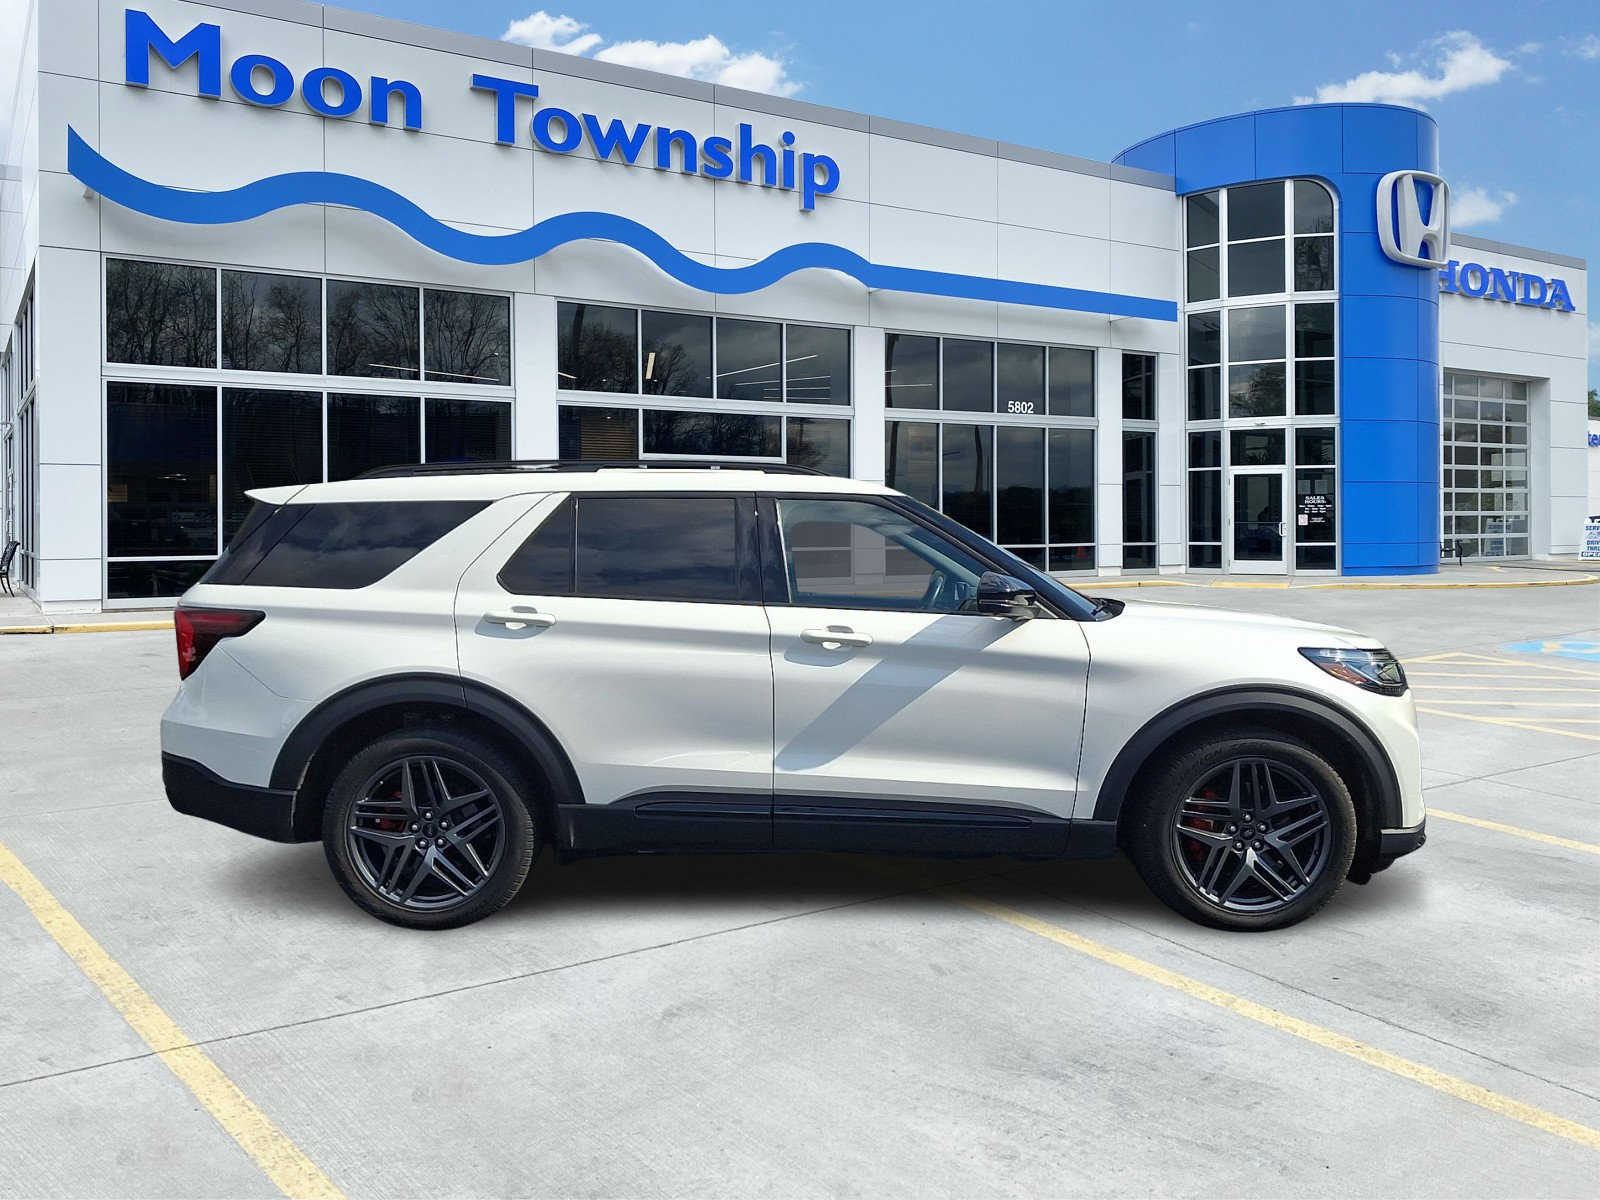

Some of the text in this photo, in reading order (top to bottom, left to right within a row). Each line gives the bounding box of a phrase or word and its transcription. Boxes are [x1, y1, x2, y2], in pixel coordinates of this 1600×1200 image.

[125, 9, 840, 212] Moon Township
[1007, 400, 1034, 414] 5802
